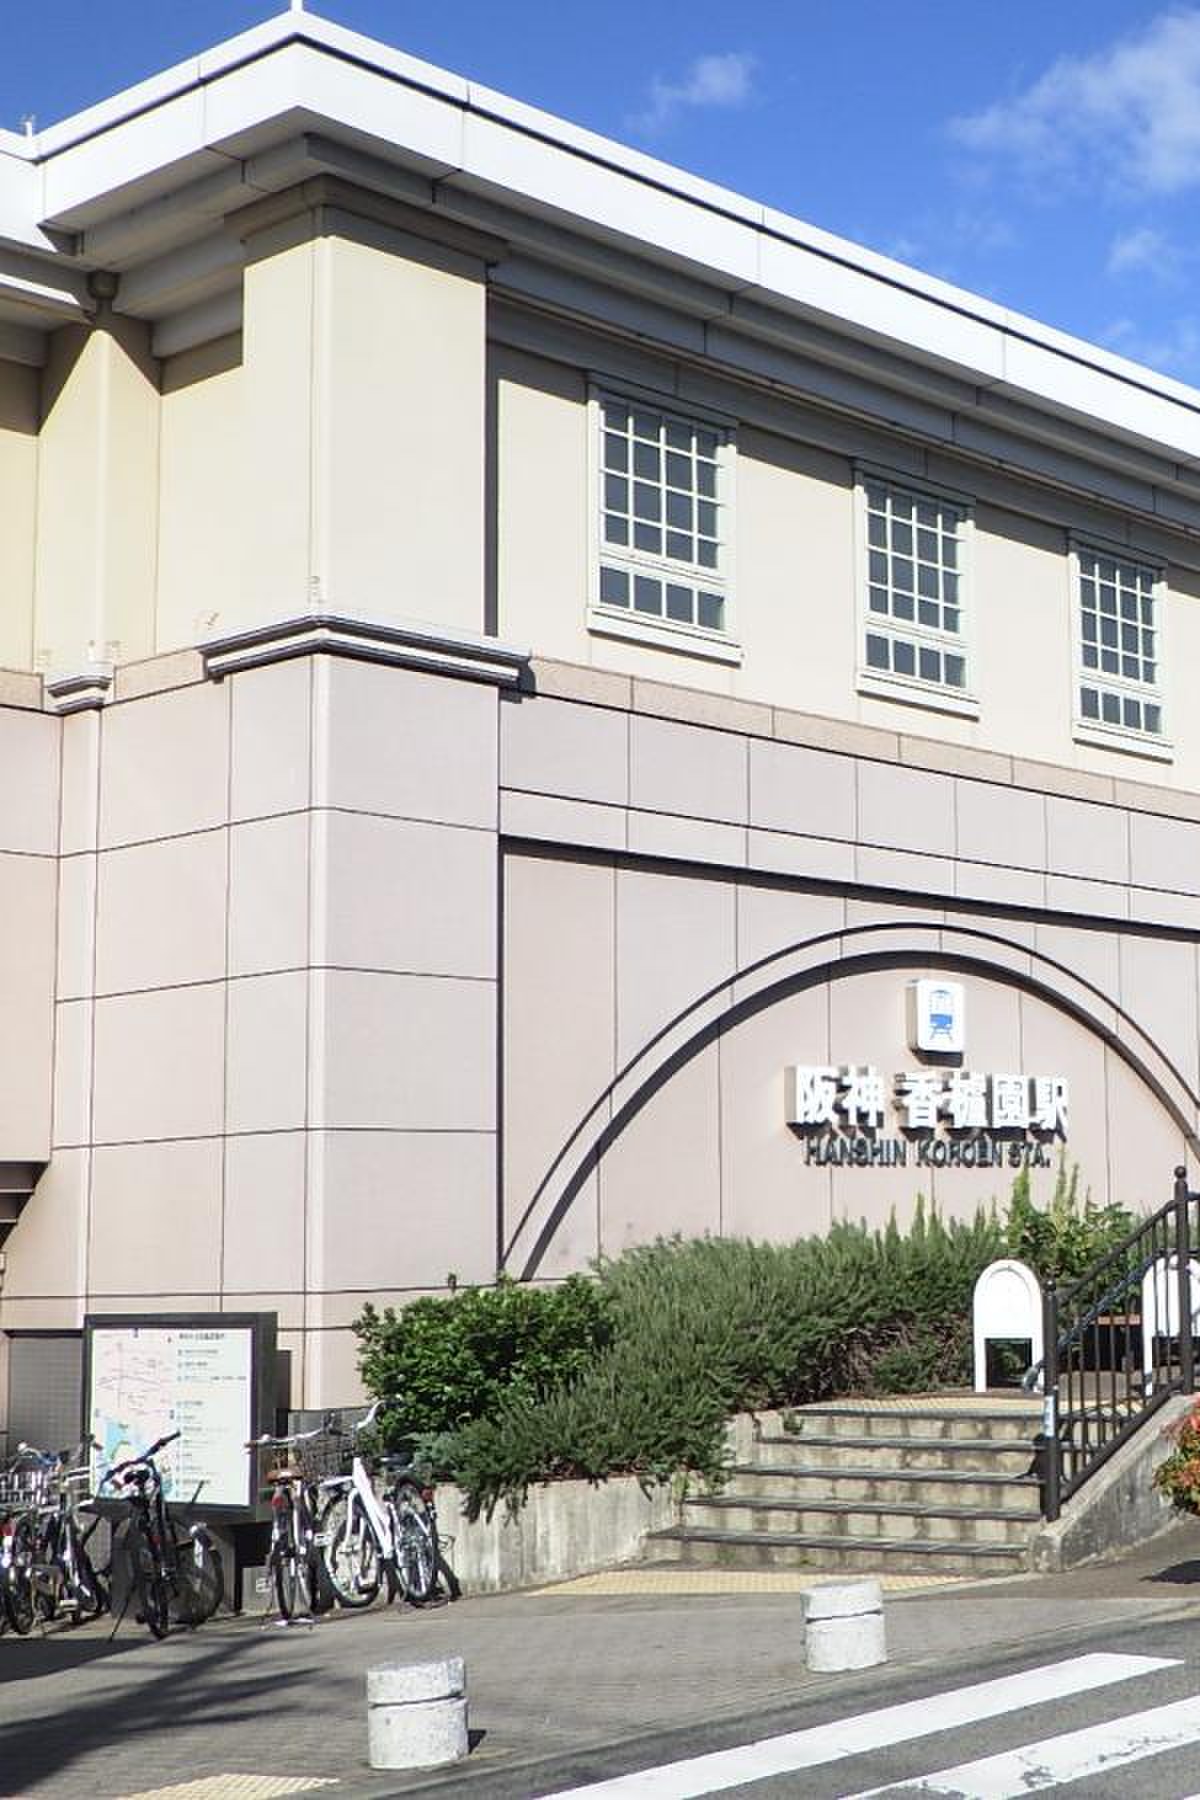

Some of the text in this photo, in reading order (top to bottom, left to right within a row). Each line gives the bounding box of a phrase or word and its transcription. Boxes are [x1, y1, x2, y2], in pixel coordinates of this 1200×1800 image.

[791, 1064, 885, 1128] 阪神
[805, 1138, 1051, 1169] HANSHIN KOROEN STA.
